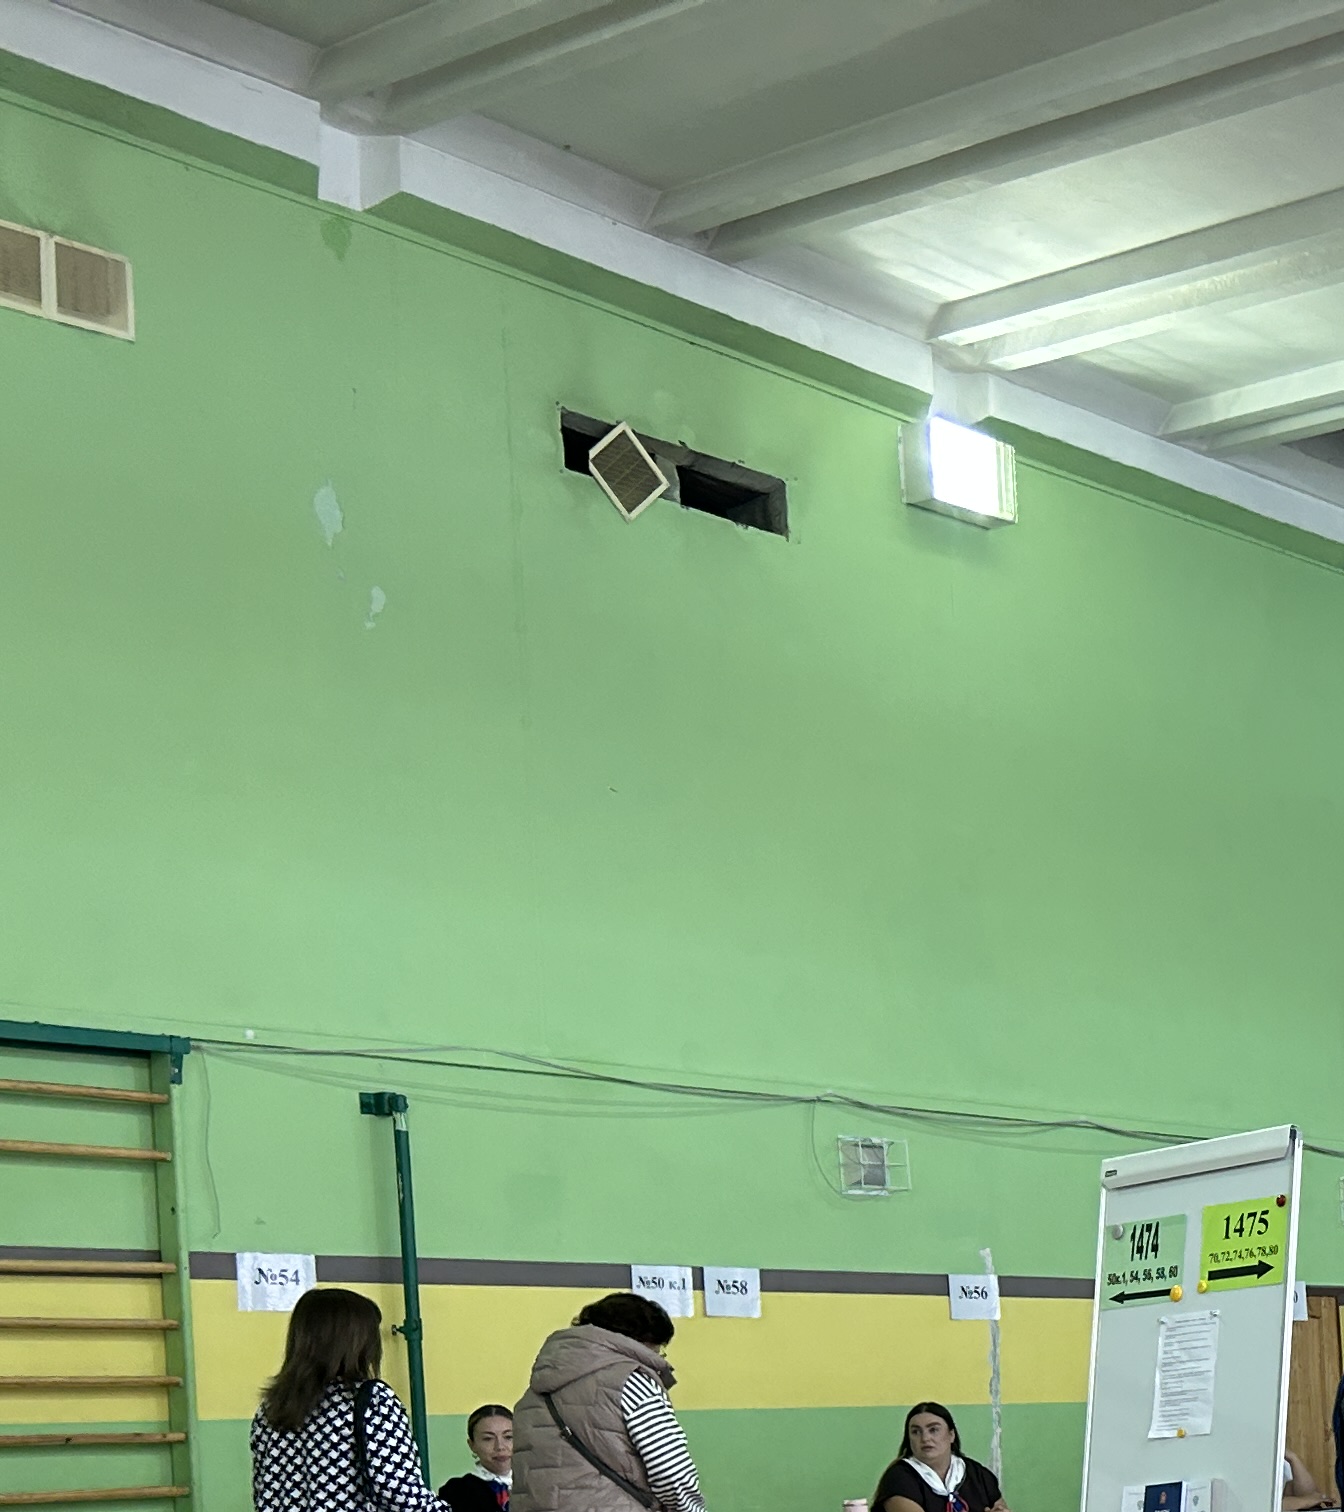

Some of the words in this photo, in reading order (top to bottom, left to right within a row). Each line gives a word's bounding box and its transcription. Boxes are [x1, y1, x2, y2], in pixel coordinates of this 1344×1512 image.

[1222, 1209, 1269, 1240] 1475
[1130, 1221, 1159, 1262] 1474
[254, 1267, 300, 1286] №54
[636, 1275, 665, 1290] №50
[668, 1277, 686, 1291] к.1
[715, 1279, 748, 1296] №58
[958, 1285, 988, 1300] №56
